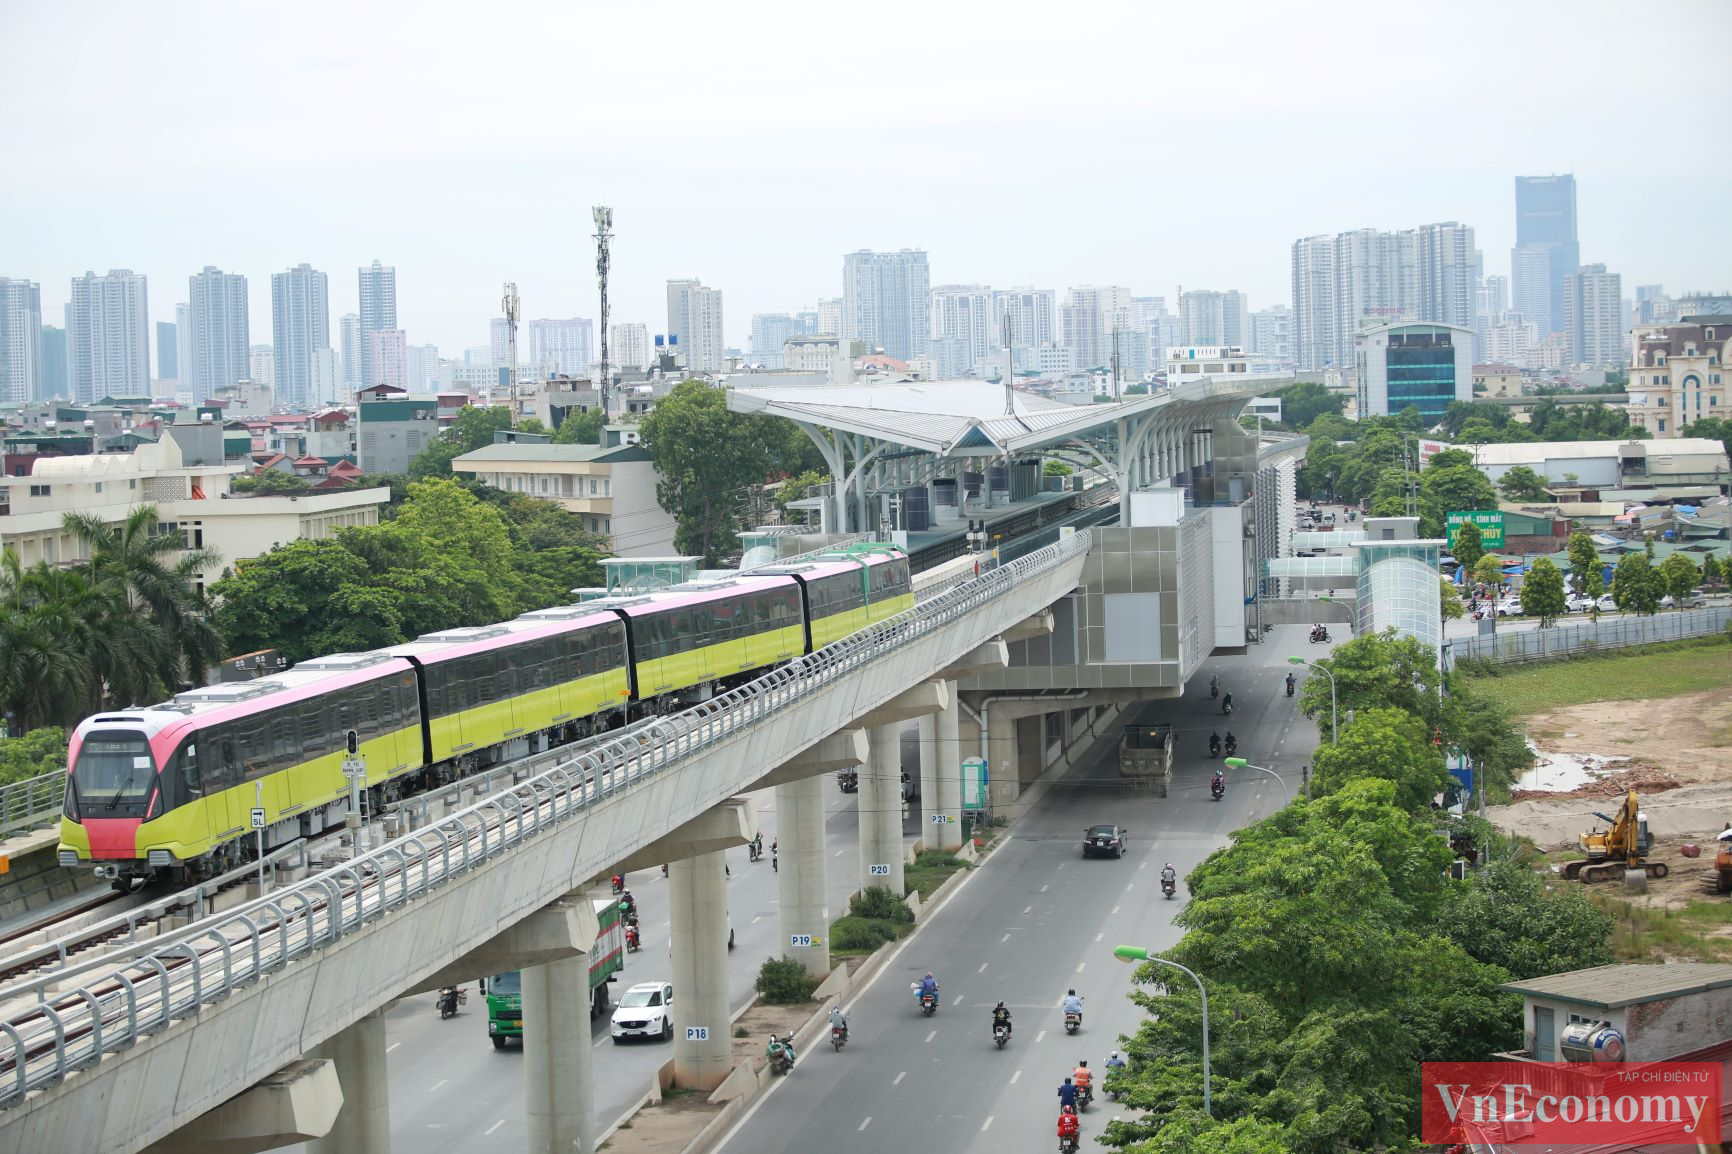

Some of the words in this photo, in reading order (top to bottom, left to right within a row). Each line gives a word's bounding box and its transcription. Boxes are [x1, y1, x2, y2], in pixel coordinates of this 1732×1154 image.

[1476, 515, 1489, 523] KÍNH
[253, 818, 263, 826] SL
[871, 865, 888, 874] P20
[792, 936, 810, 945] P19
[687, 1028, 706, 1039] P18
